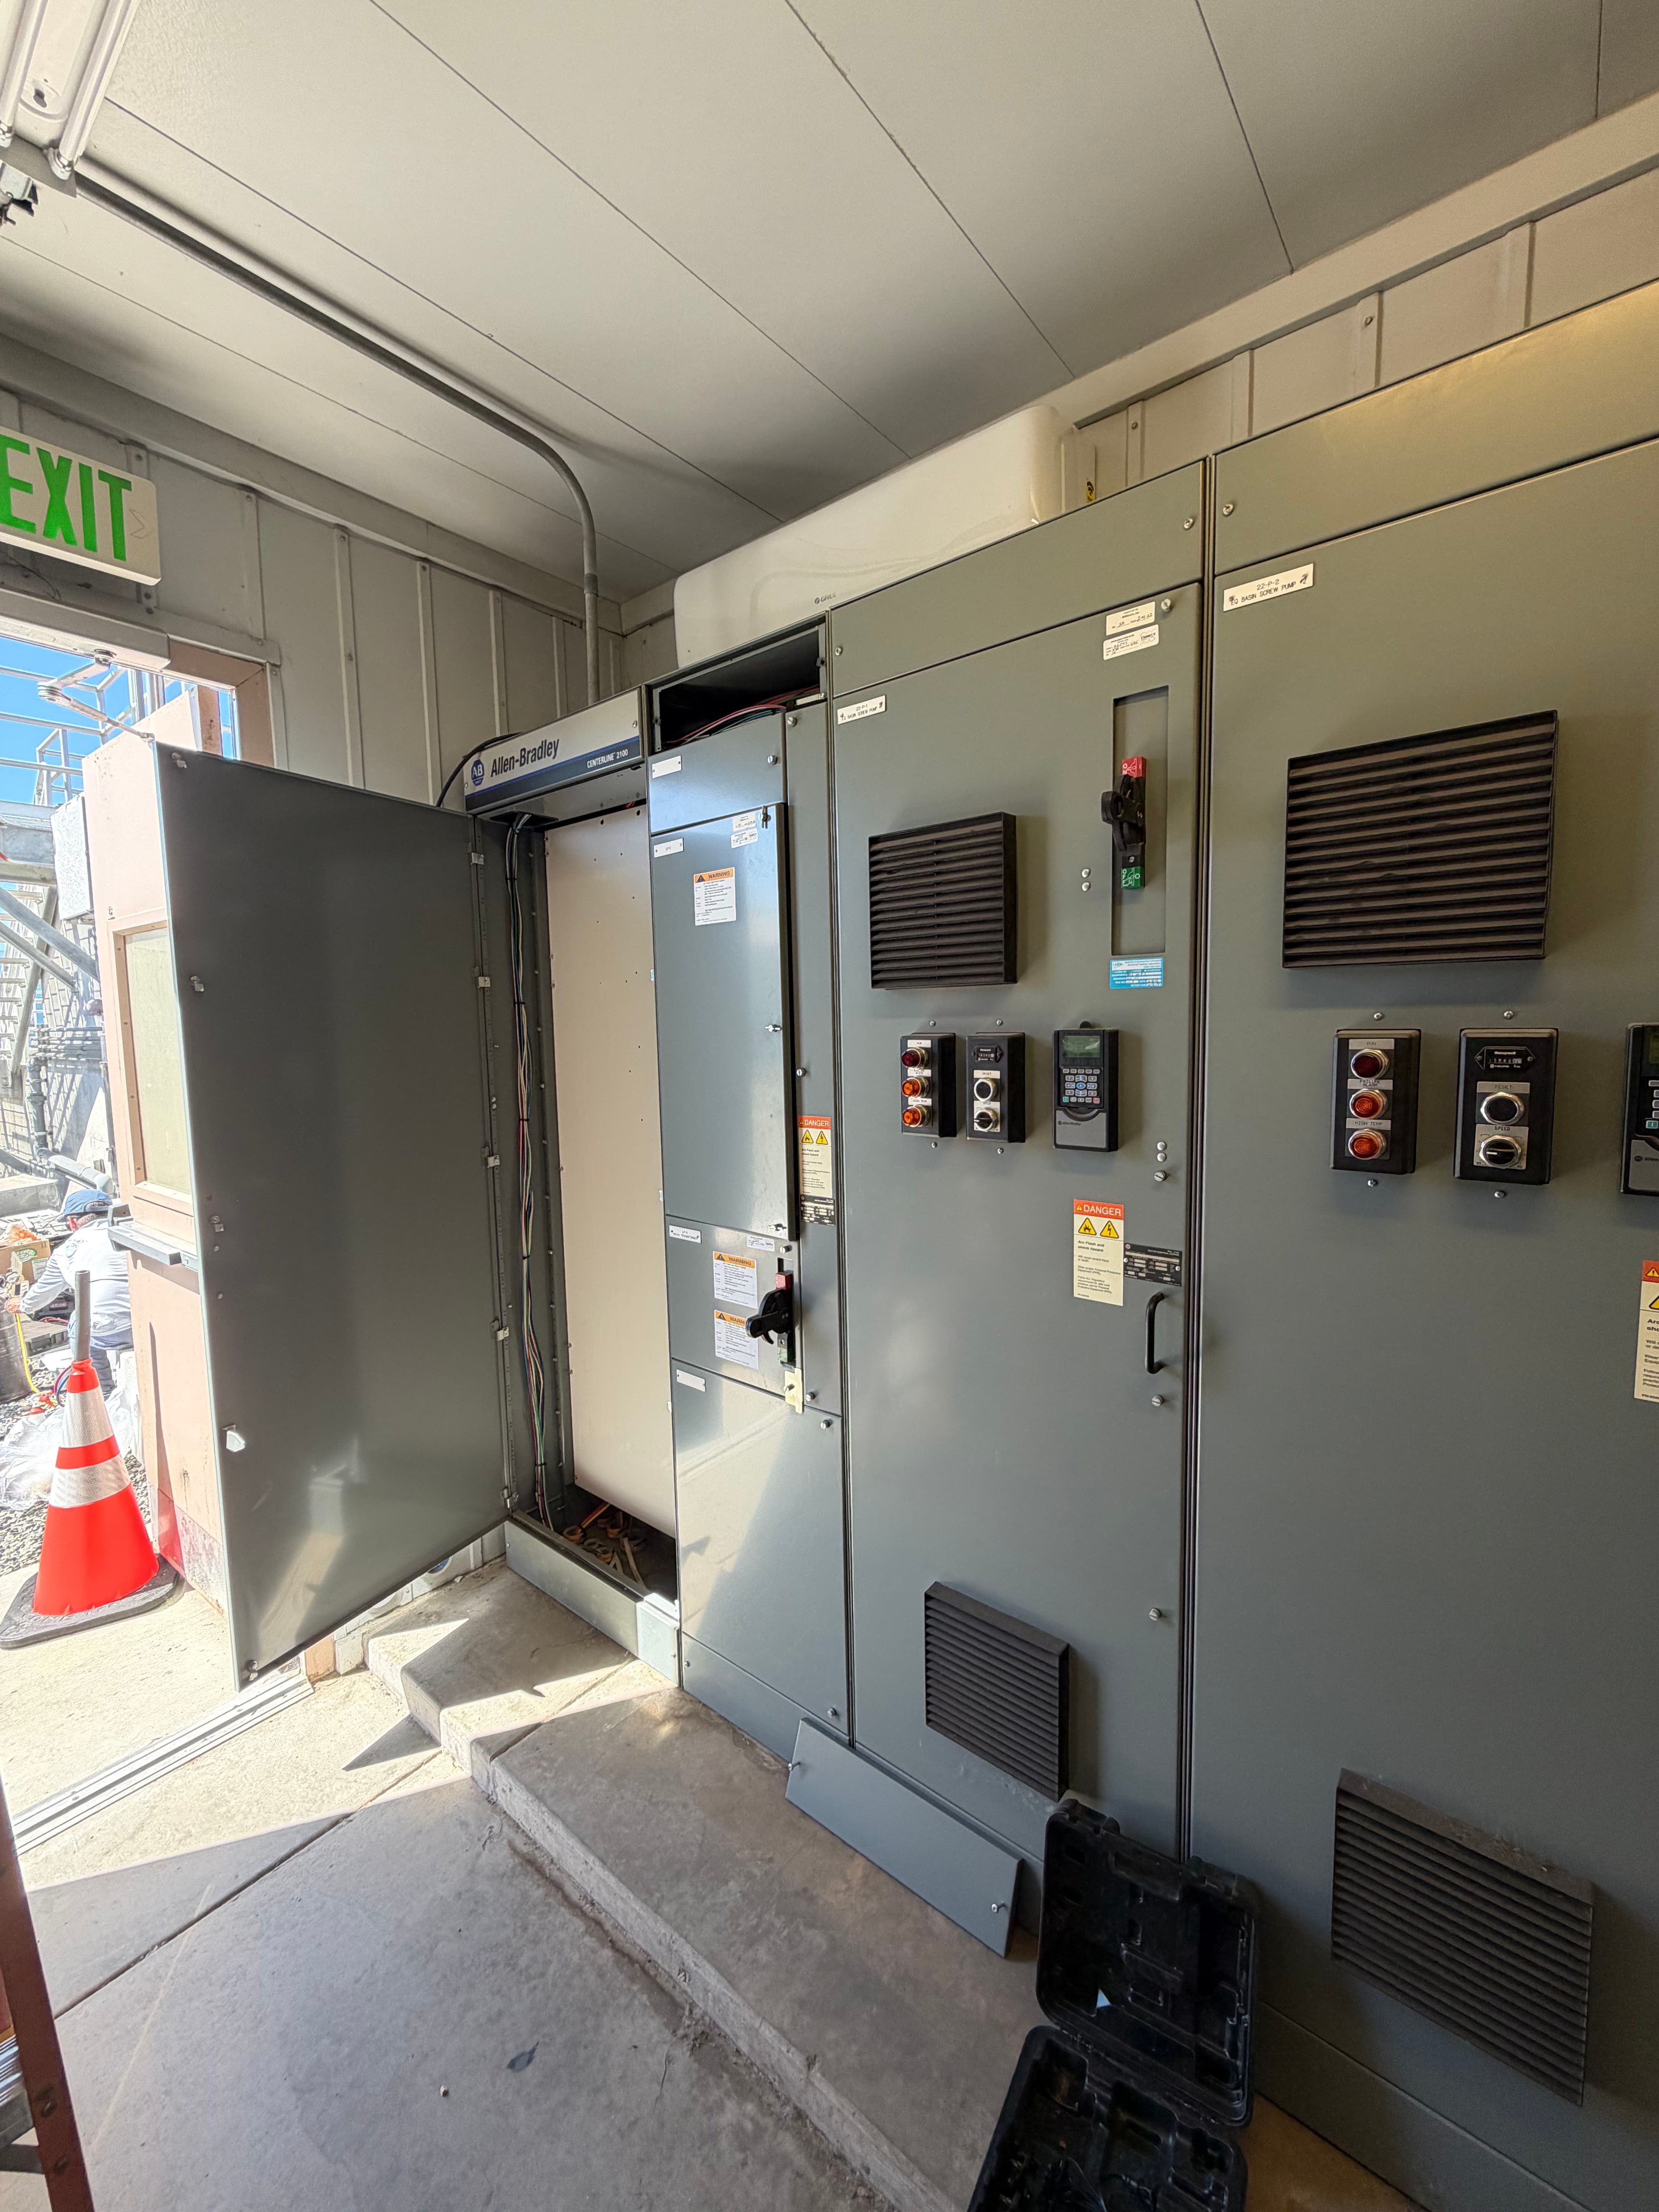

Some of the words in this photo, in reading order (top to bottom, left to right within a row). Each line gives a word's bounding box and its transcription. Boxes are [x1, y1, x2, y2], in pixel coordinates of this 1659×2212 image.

[0, 434, 132, 561] EXIT
[1256, 579, 1280, 591] 22-P-2
[1241, 594, 1257, 603] BASIN
[1259, 587, 1278, 597] SCREW
[1281, 581, 1296, 591] PUMP
[490, 738, 559, 778] Allen-Bradley
[616, 749, 628, 760] 2100
[472, 764, 483, 779] AB
[1122, 763, 1128, 775] ON
[708, 871, 730, 879] WARNING
[1083, 1205, 1122, 1217] DANGER
[728, 1256, 751, 1265] WARNING
